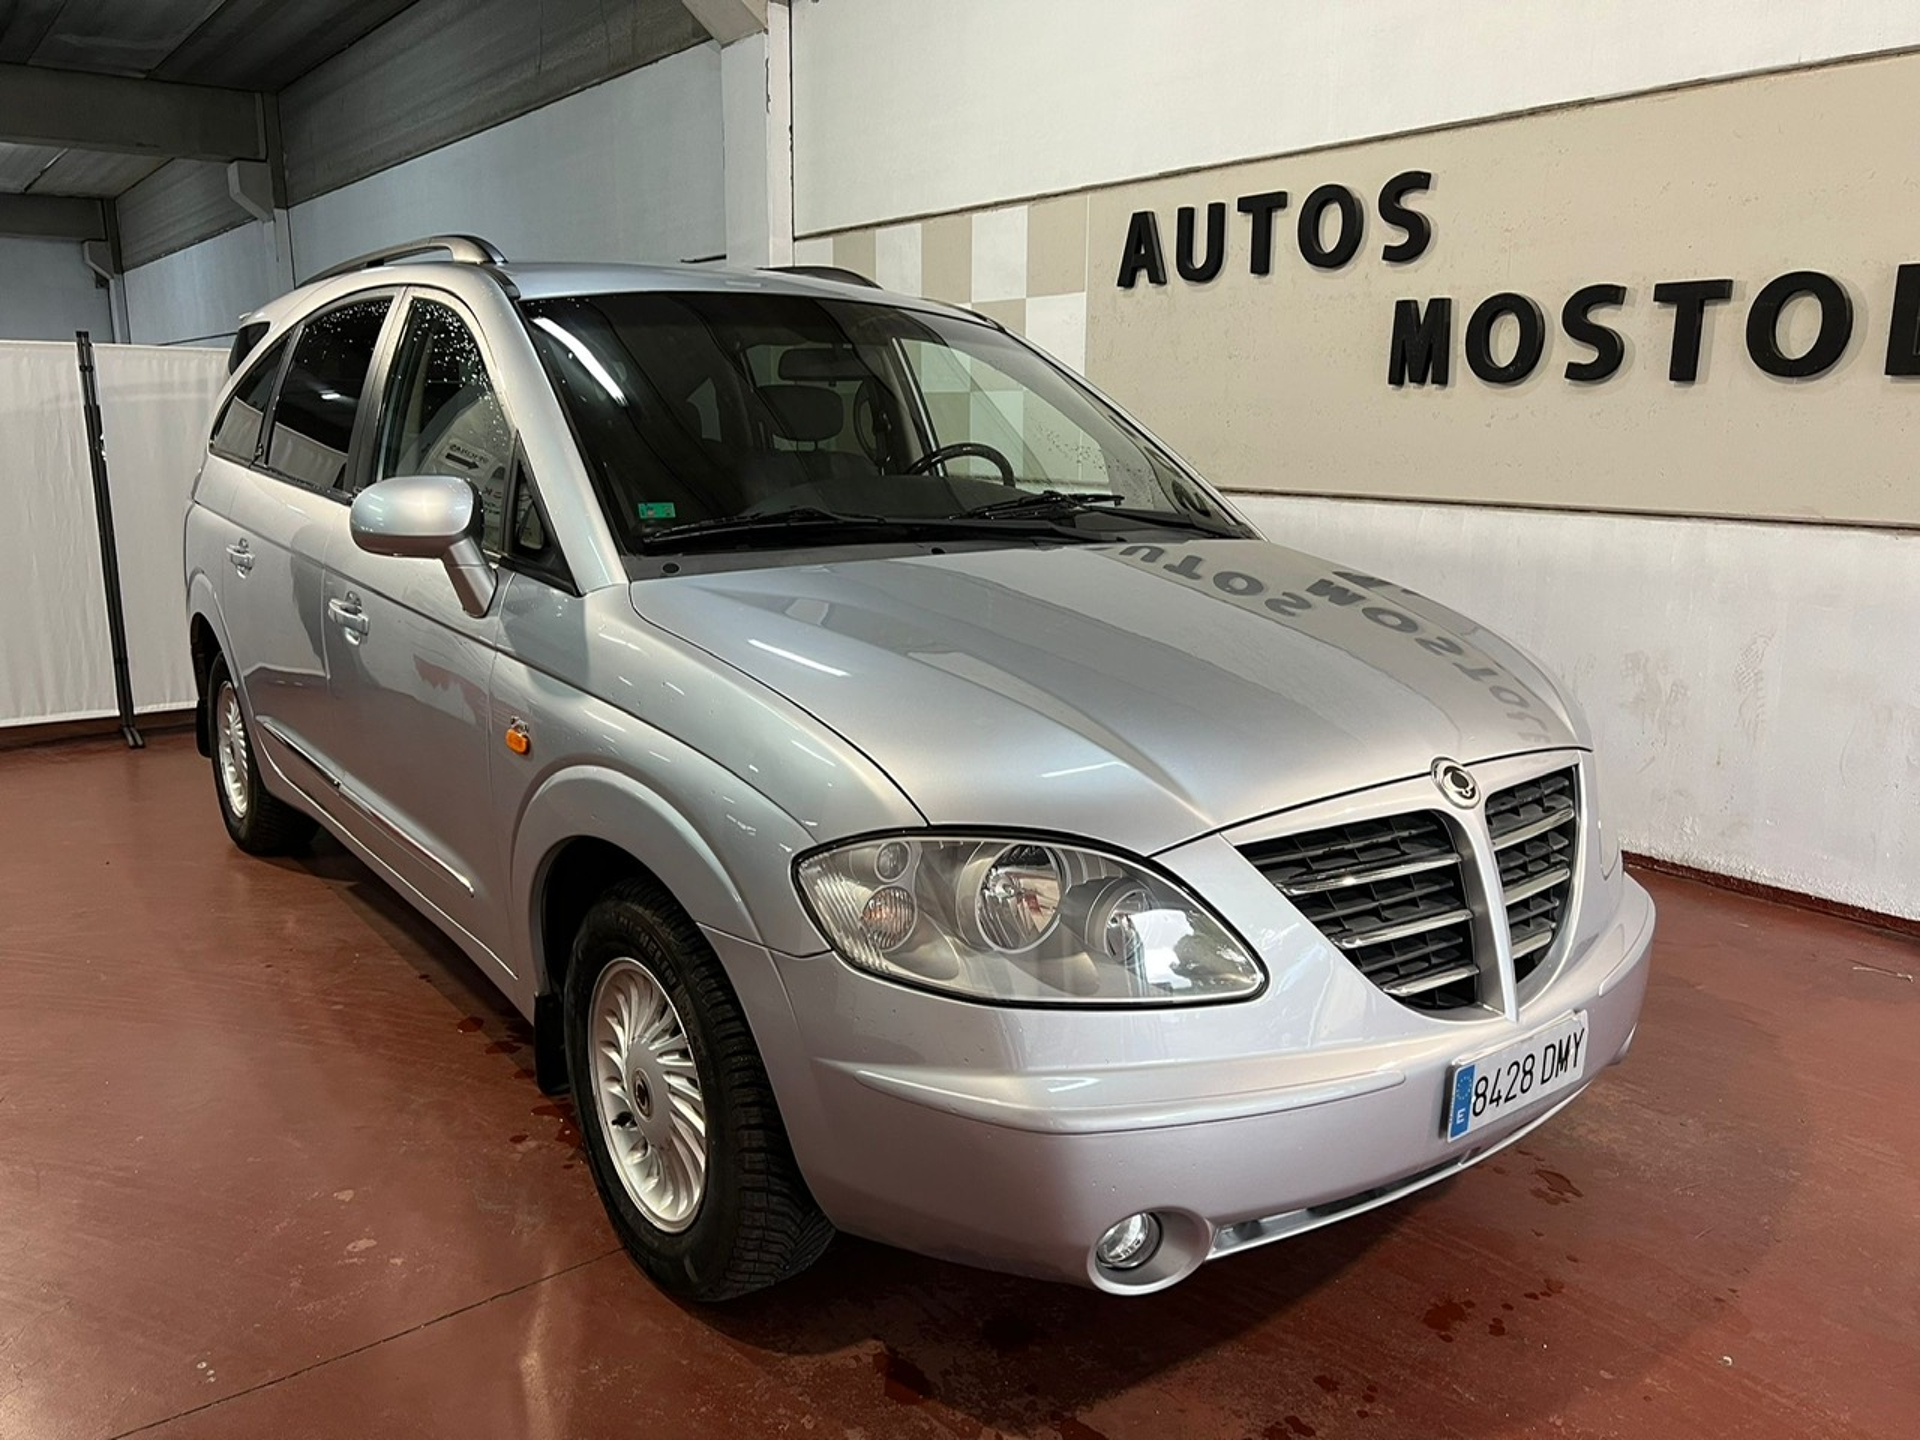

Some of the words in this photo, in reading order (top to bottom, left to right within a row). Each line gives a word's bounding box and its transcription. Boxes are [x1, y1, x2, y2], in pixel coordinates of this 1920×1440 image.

[1117, 170, 1432, 288] AUTOS
[1456, 1108, 1466, 1124] E
[1472, 1053, 1536, 1117] 8428
[1540, 1028, 1585, 1085] DMY
